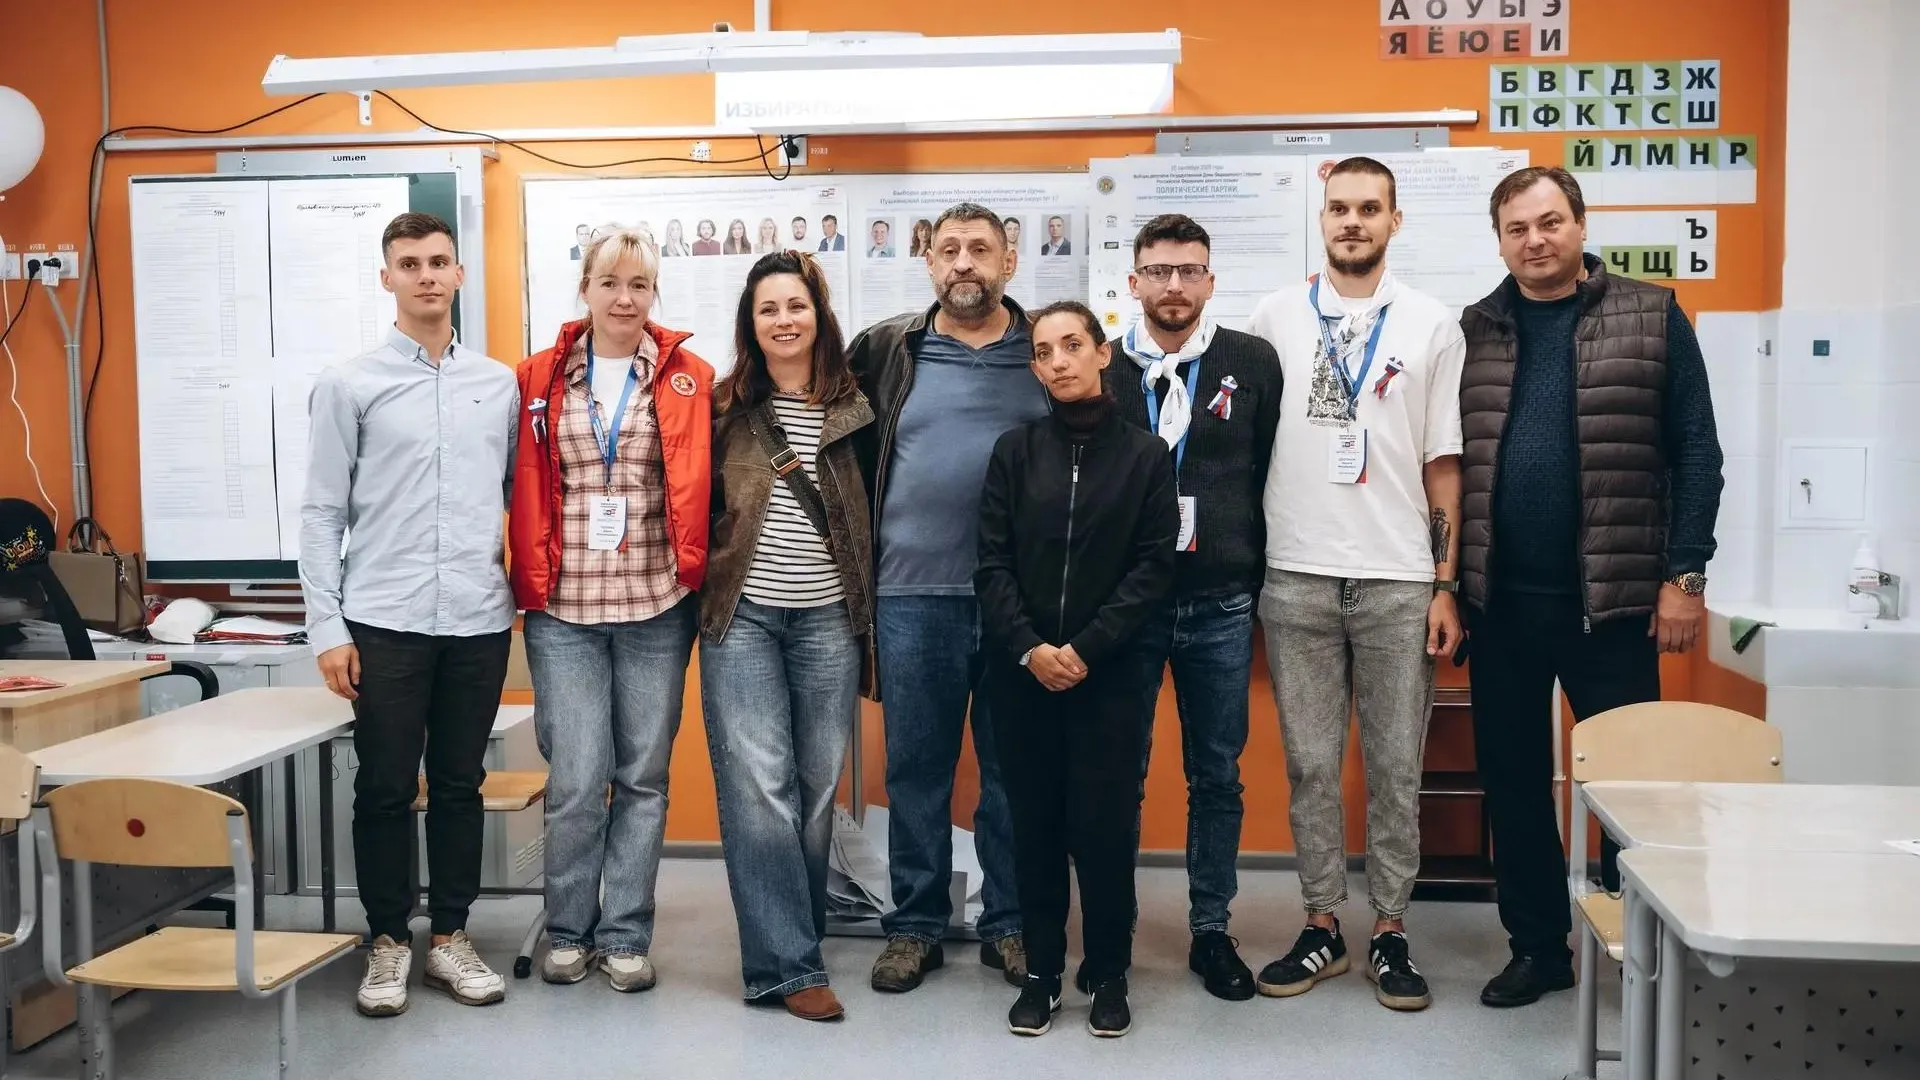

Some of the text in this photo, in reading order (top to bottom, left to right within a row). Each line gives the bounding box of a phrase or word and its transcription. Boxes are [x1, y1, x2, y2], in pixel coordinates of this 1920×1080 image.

[1388, 0, 1561, 20] А О У Ы Э
[1389, 26, 1561, 54] Я Ё Ю Е И
[1501, 67, 1716, 95] Б В Г Д З Ж
[1500, 100, 1715, 127] П Ф К Т С Ш
[1574, 139, 1748, 166] Й Л М Н Р
[1156, 185, 1238, 194] ПОЛИТИЧЕСКИЕ ПАРТИИ
[1685, 218, 1708, 240] Ъ
[1611, 251, 1708, 278] Ч Щ Ь
